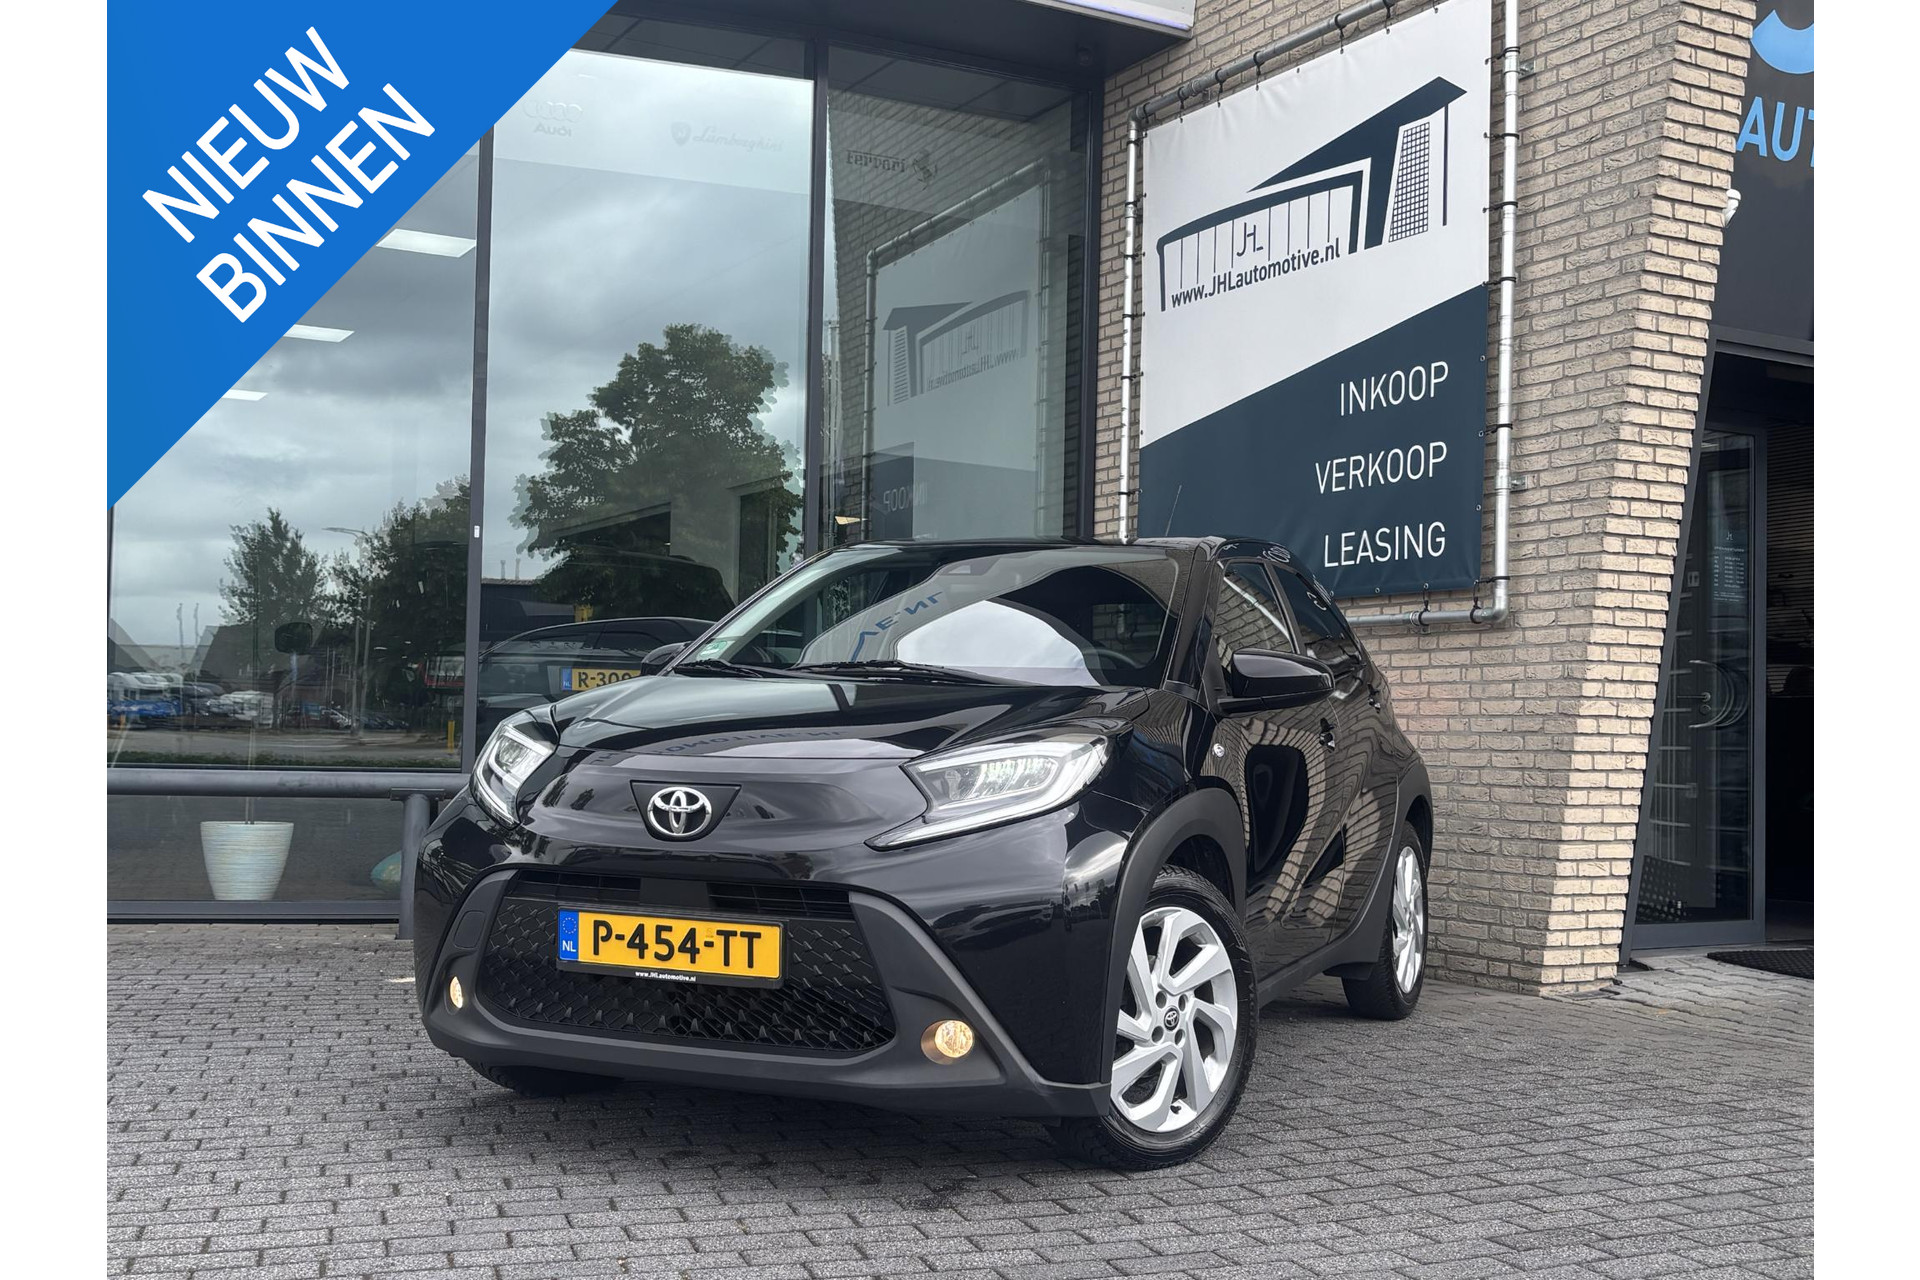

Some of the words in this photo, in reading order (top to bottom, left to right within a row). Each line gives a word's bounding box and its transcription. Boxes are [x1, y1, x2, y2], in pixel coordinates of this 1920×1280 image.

[533, 121, 572, 137] Audi
[1736, 96, 1815, 168] AU
[1236, 222, 1264, 257] JHL
[1171, 237, 1341, 308] www.JHLautomotive.nl
[1340, 360, 1449, 416] INKOOP
[1315, 441, 1448, 494] VERKOOP
[1324, 521, 1447, 568] LEASING
[562, 940, 577, 952] NL
[593, 919, 762, 969] P-454-TT
